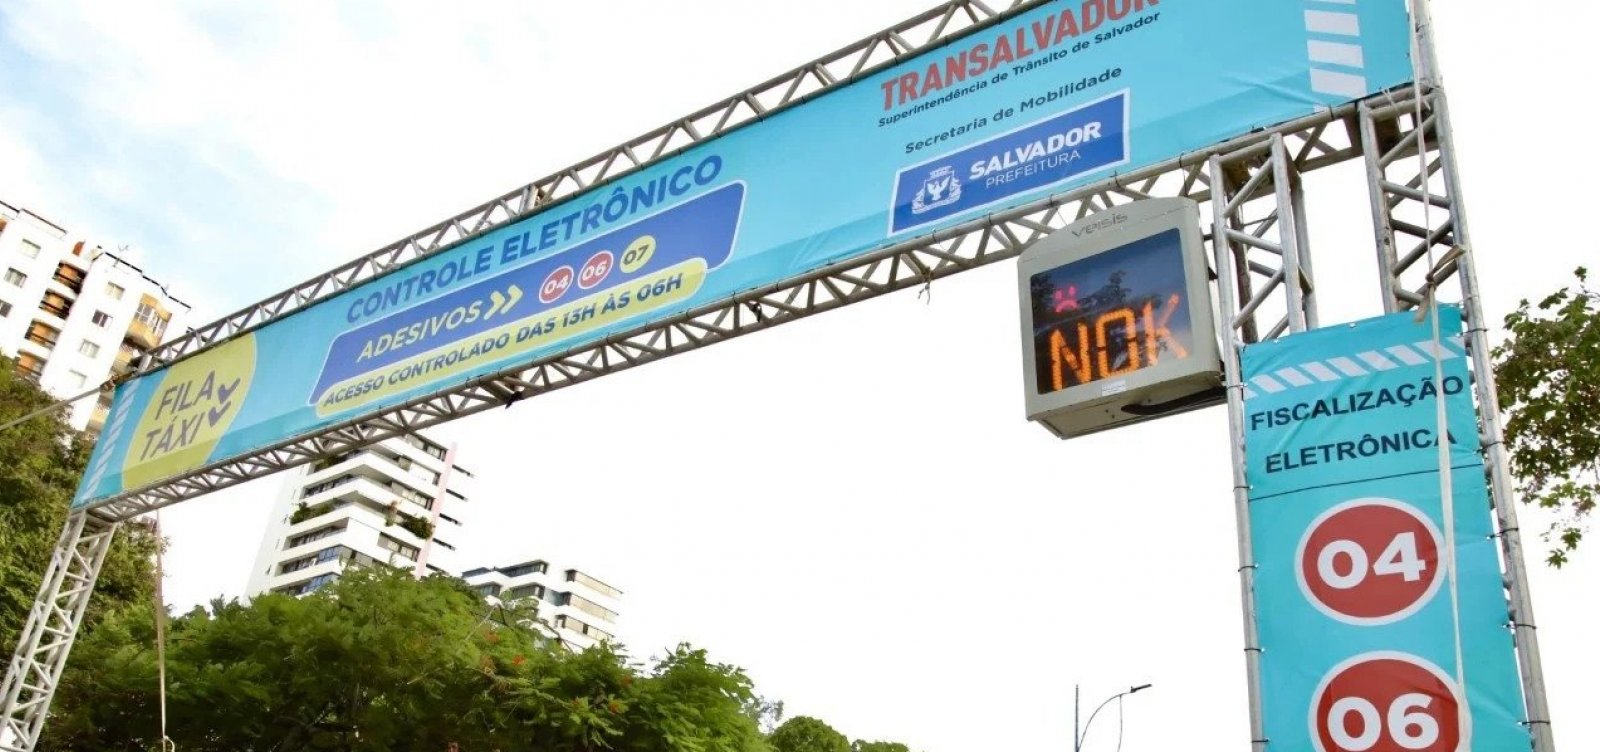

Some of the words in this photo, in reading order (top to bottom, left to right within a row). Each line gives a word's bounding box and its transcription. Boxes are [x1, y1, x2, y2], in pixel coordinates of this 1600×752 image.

[878, 80, 988, 127] Superintendência
[992, 71, 1008, 84] de
[1011, 48, 1068, 77] Trânsito
[1072, 40, 1090, 53] de
[1094, 12, 1160, 44] Salvador
[905, 115, 988, 154] Secretaria
[993, 106, 1014, 122] de
[1019, 65, 1122, 112] Mobilidade
[969, 121, 1101, 180] SALVADOR
[985, 149, 1081, 188] PREFEITURA
[347, 245, 493, 323] CONTROLE
[500, 155, 723, 265] ELETRÔNICO
[357, 303, 481, 362] ADESIVOS
[544, 274, 569, 294] 04
[582, 260, 607, 281] 06
[623, 244, 649, 266] 07
[323, 375, 384, 406] ACESSO
[388, 333, 509, 386] CONTROLADO
[516, 315, 556, 343] DAS
[601, 293, 631, 315] ÀS
[637, 272, 683, 301] 06H
[1050, 293, 1188, 391] NOK
[155, 370, 216, 420] FILA
[1250, 375, 1464, 431] FISCALIZAÇÃO
[139, 412, 206, 462] TÁXI
[1317, 532, 1426, 590] 04
[1327, 693, 1440, 752] 06
